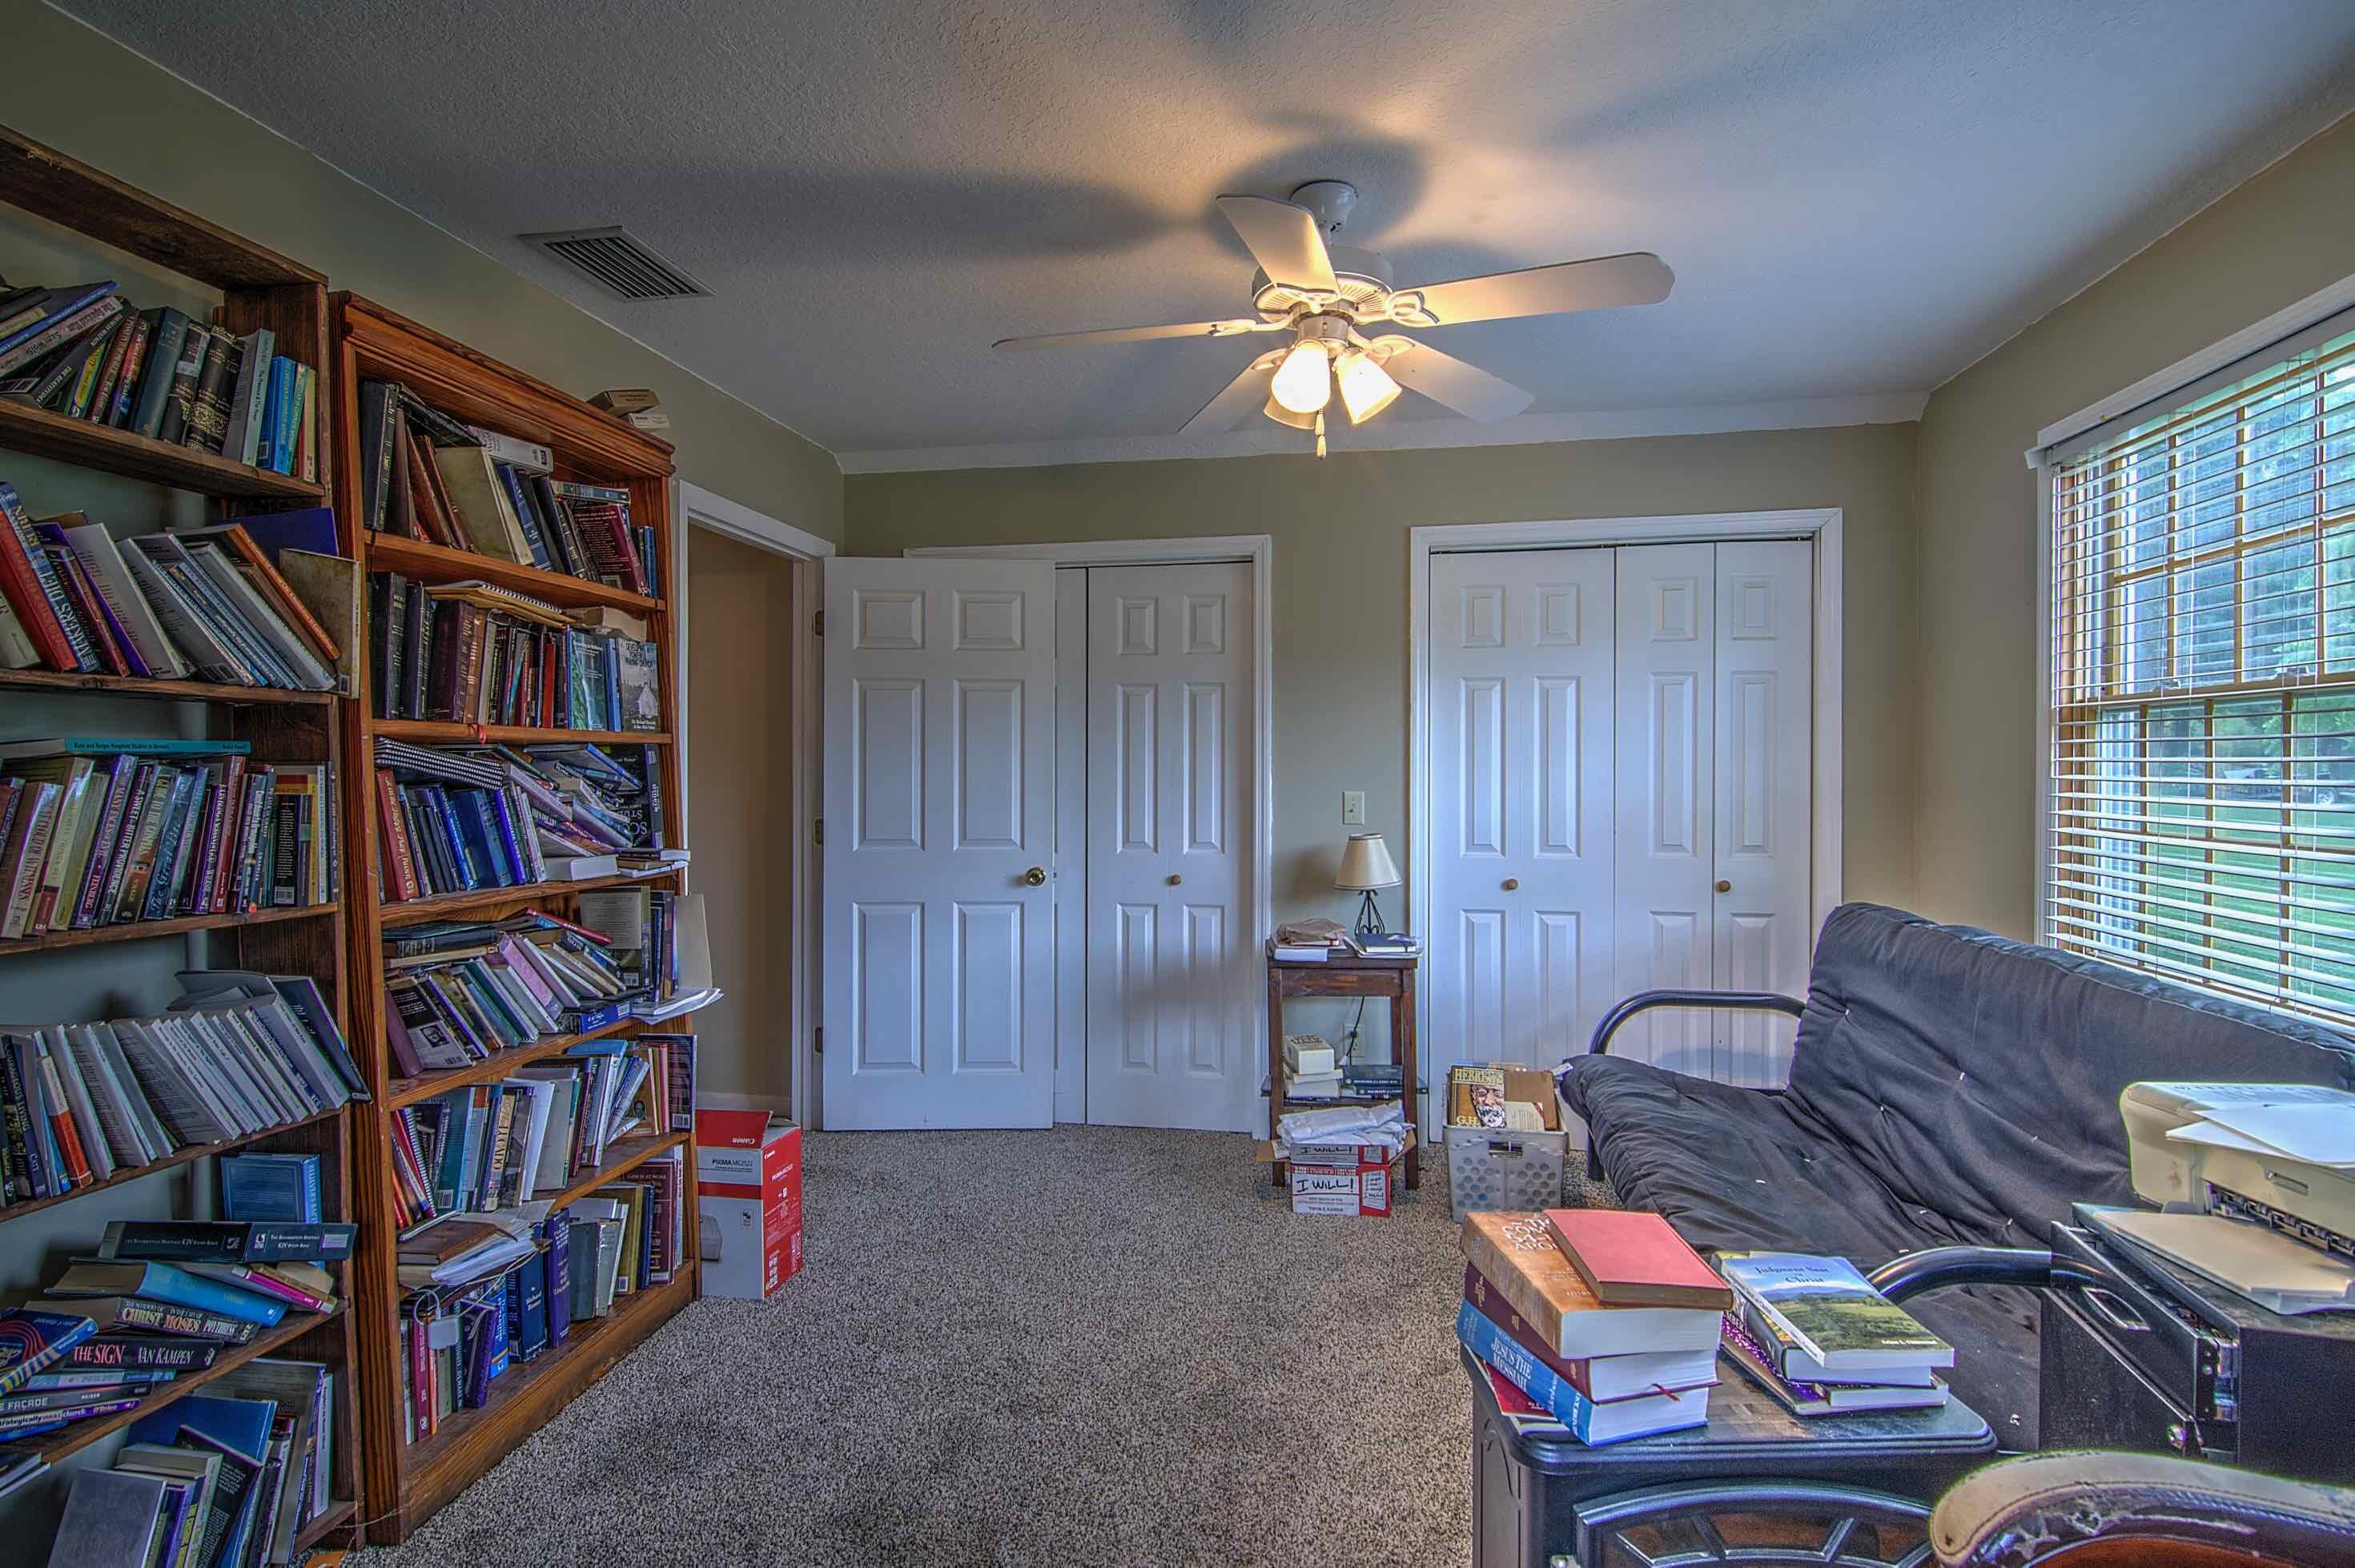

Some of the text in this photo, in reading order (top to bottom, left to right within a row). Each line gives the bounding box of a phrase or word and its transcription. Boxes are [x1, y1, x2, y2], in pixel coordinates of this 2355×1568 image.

[38, 564, 62, 601] DIET
[127, 795, 144, 819] SWEET
[144, 811, 161, 823] THE
[119, 824, 135, 849] BITTER
[106, 849, 128, 893] PROVIDENCE
[16, 1100, 30, 1131] LIVING
[492, 1124, 508, 1170] LUCADO
[1300, 1146, 1311, 1154] I
[1296, 1179, 1309, 1192] I
[1754, 1266, 1804, 1274] Judgment
[121, 1307, 200, 1333] CHRIST MOSES
[73, 1345, 126, 1364] THE SIGN
[138, 1346, 193, 1364] VAN KAMPEN
[1491, 1337, 1516, 1368] JESUS
[1516, 1355, 1533, 1380] THE
[1493, 1353, 1528, 1392] MESSIAH
[0, 1414, 42, 1427] rategically
[63, 1407, 85, 1417] church
